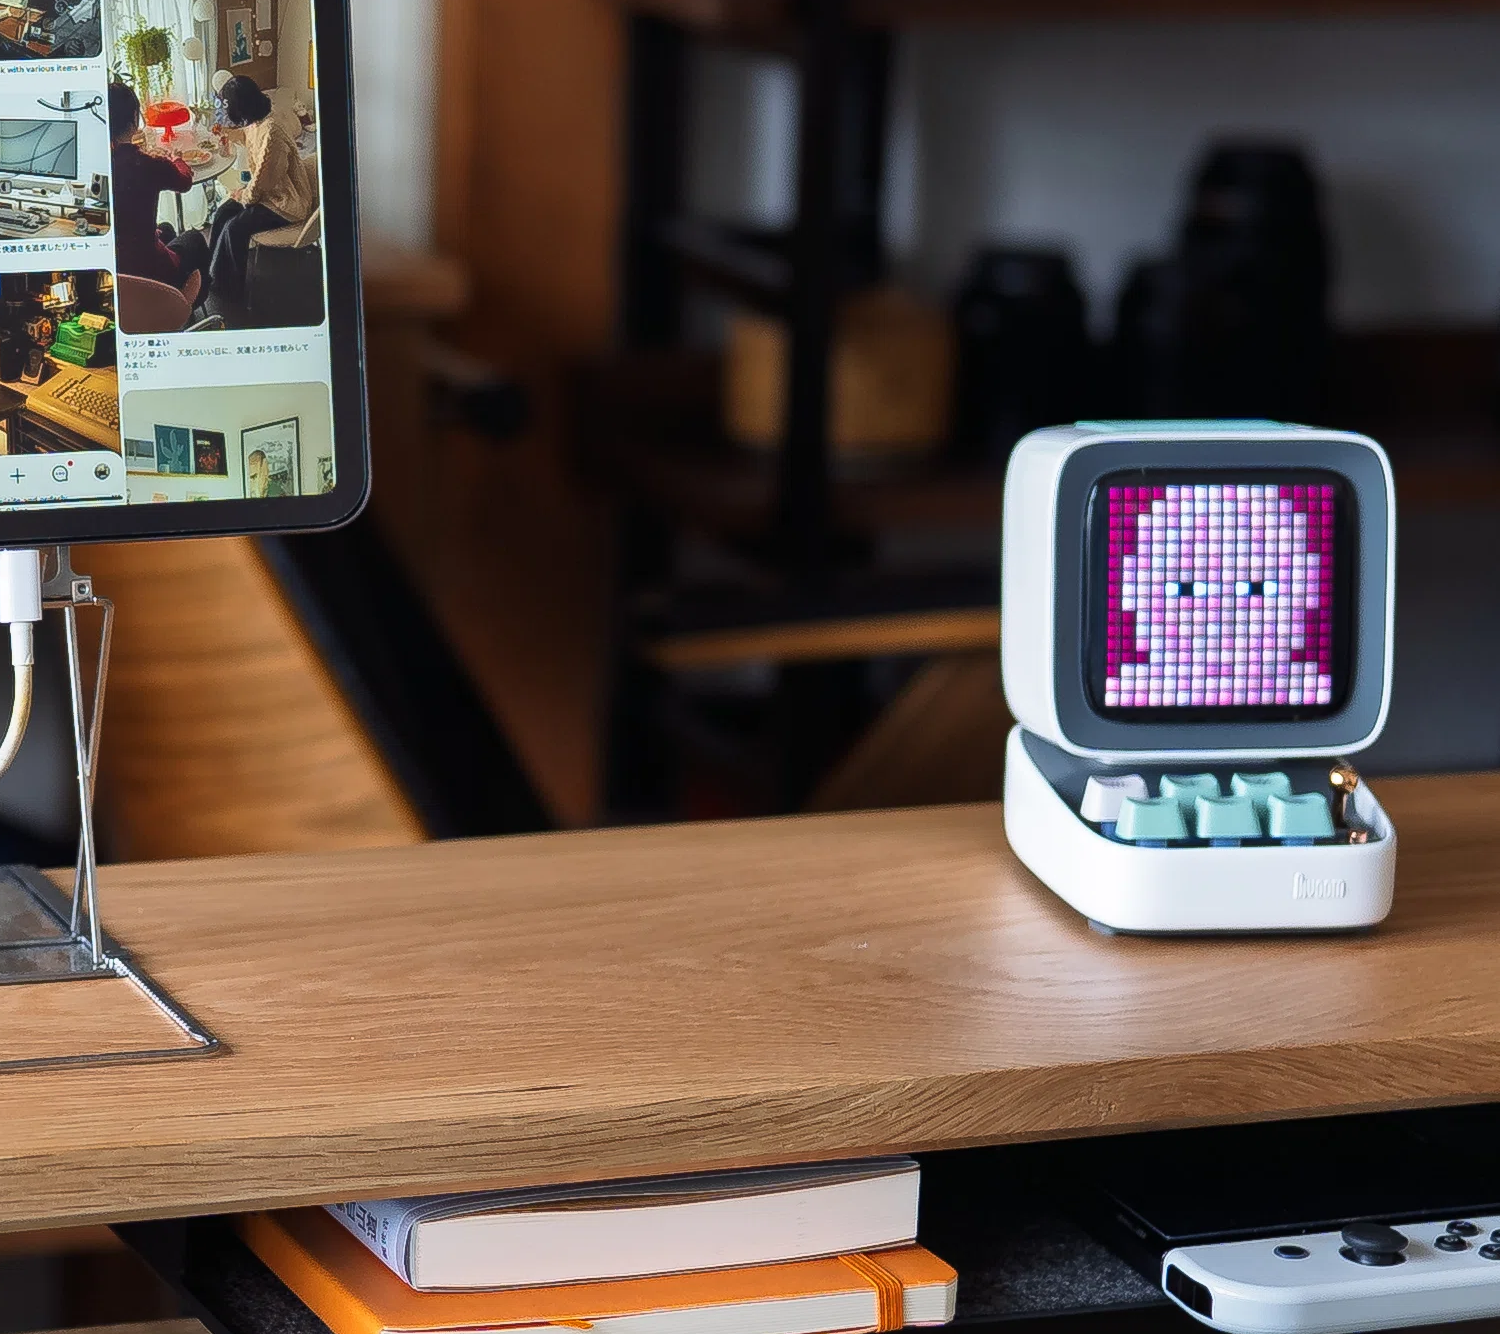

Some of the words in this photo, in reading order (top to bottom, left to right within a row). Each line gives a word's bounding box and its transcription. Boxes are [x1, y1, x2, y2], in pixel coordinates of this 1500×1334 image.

[7, 66, 24, 74] with
[25, 65, 55, 73] various
[56, 64, 78, 72] items
[79, 64, 88, 72] in
[124, 340, 146, 348] キリン
